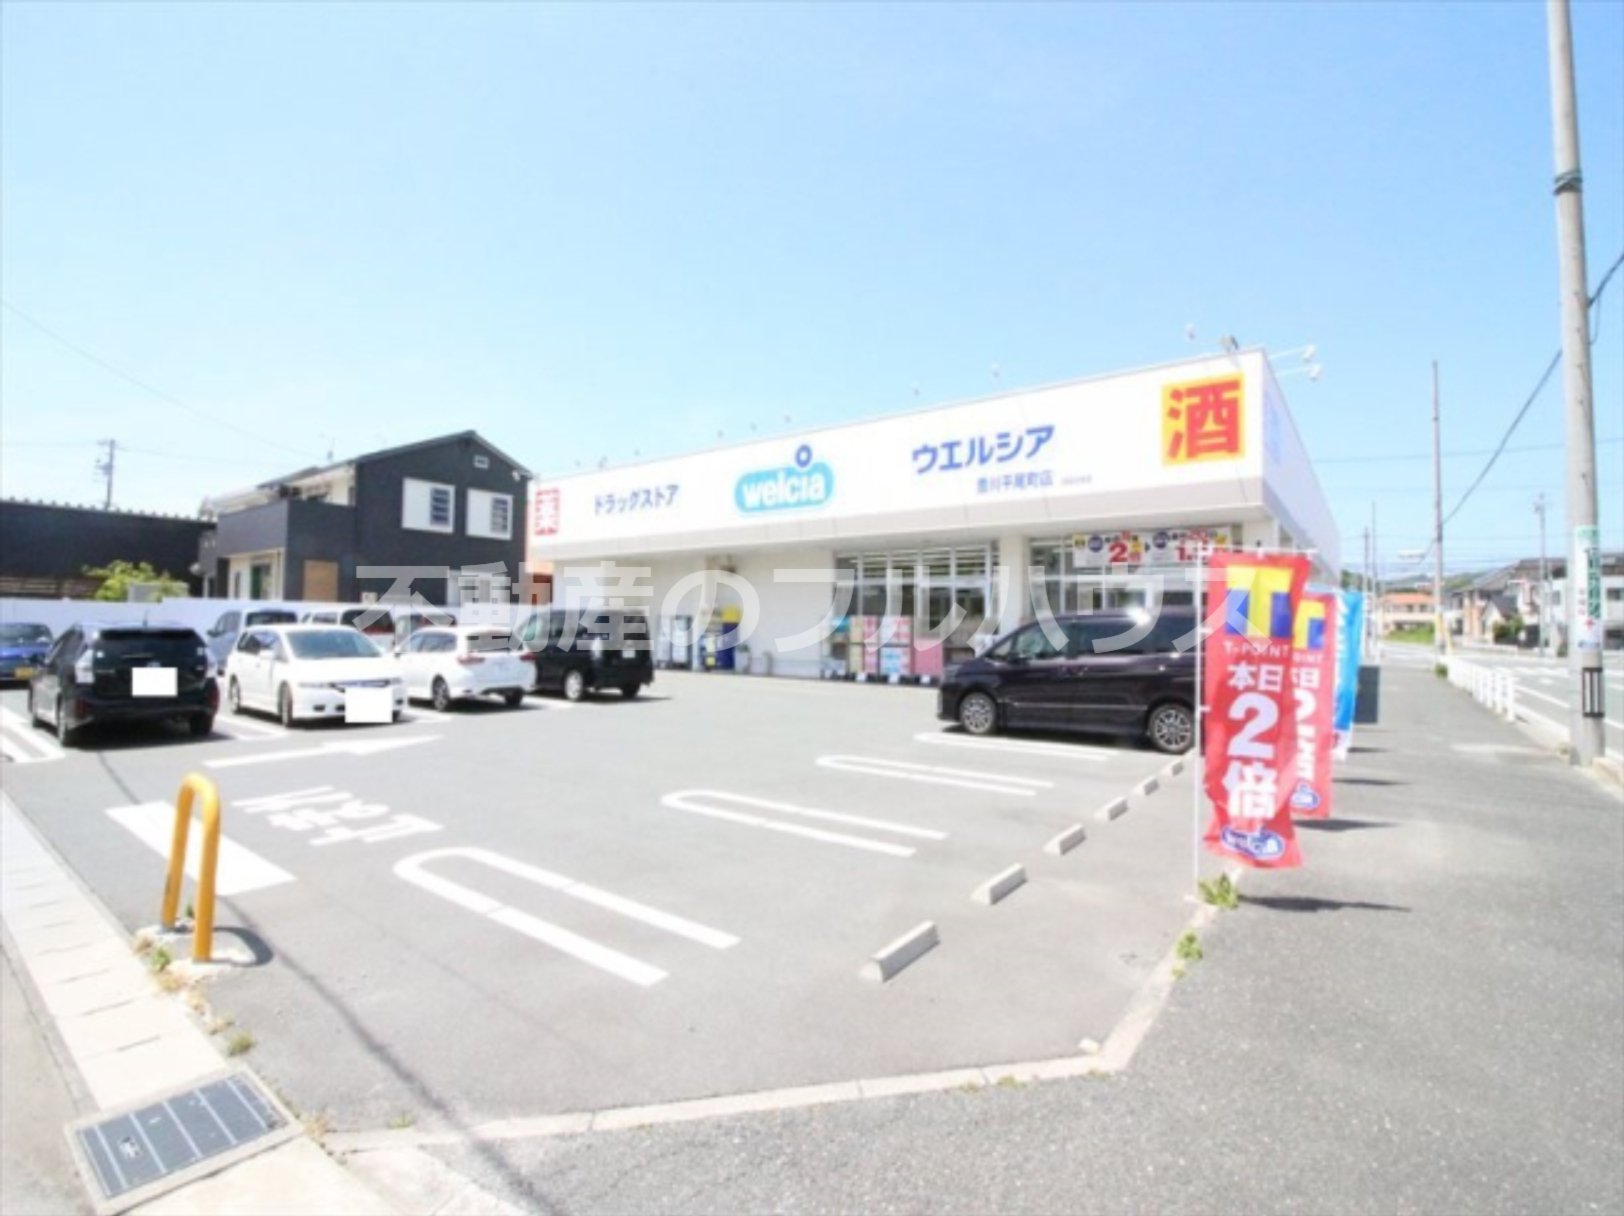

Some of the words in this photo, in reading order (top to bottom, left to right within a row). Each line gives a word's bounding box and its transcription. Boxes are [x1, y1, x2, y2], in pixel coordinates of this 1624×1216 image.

[1166, 379, 1241, 460] 酒
[741, 446, 826, 507] welcia
[911, 423, 1055, 475] ウエルシア
[594, 484, 680, 515] ドラッグストア
[1227, 663, 1283, 692] 本日
[1227, 692, 1279, 759] 2
[1222, 761, 1278, 819] 倍
